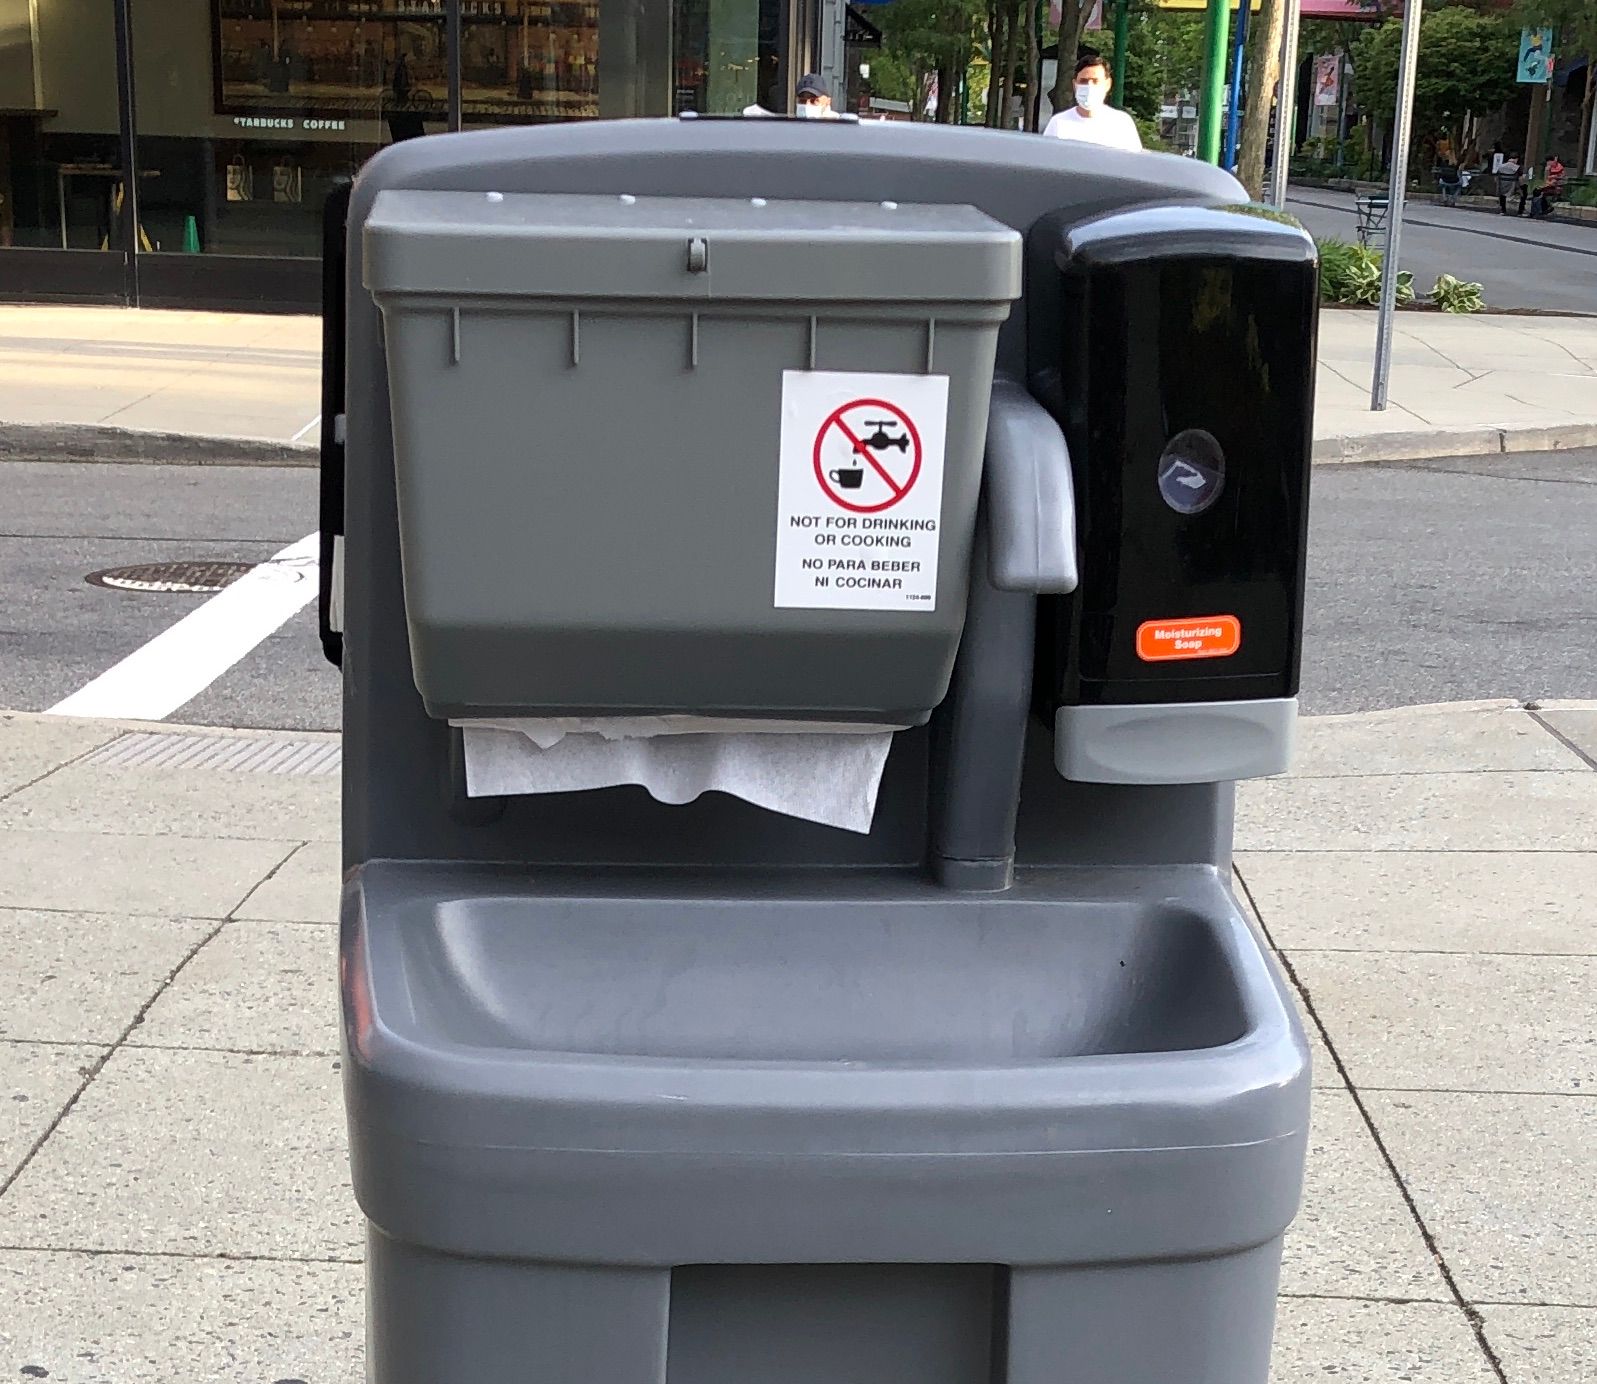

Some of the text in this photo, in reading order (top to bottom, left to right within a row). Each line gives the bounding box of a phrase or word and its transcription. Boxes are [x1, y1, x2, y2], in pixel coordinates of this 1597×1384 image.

[303, 119, 346, 130] COFFEE
[790, 516, 936, 531] NOT FOR DRINKING
[814, 534, 911, 548] OR COOKING
[802, 559, 921, 572] NO PARA BEBER
[815, 576, 902, 589] NI COCINAR
[1154, 627, 1223, 640] Moisturizing
[1174, 640, 1203, 650] Soap
